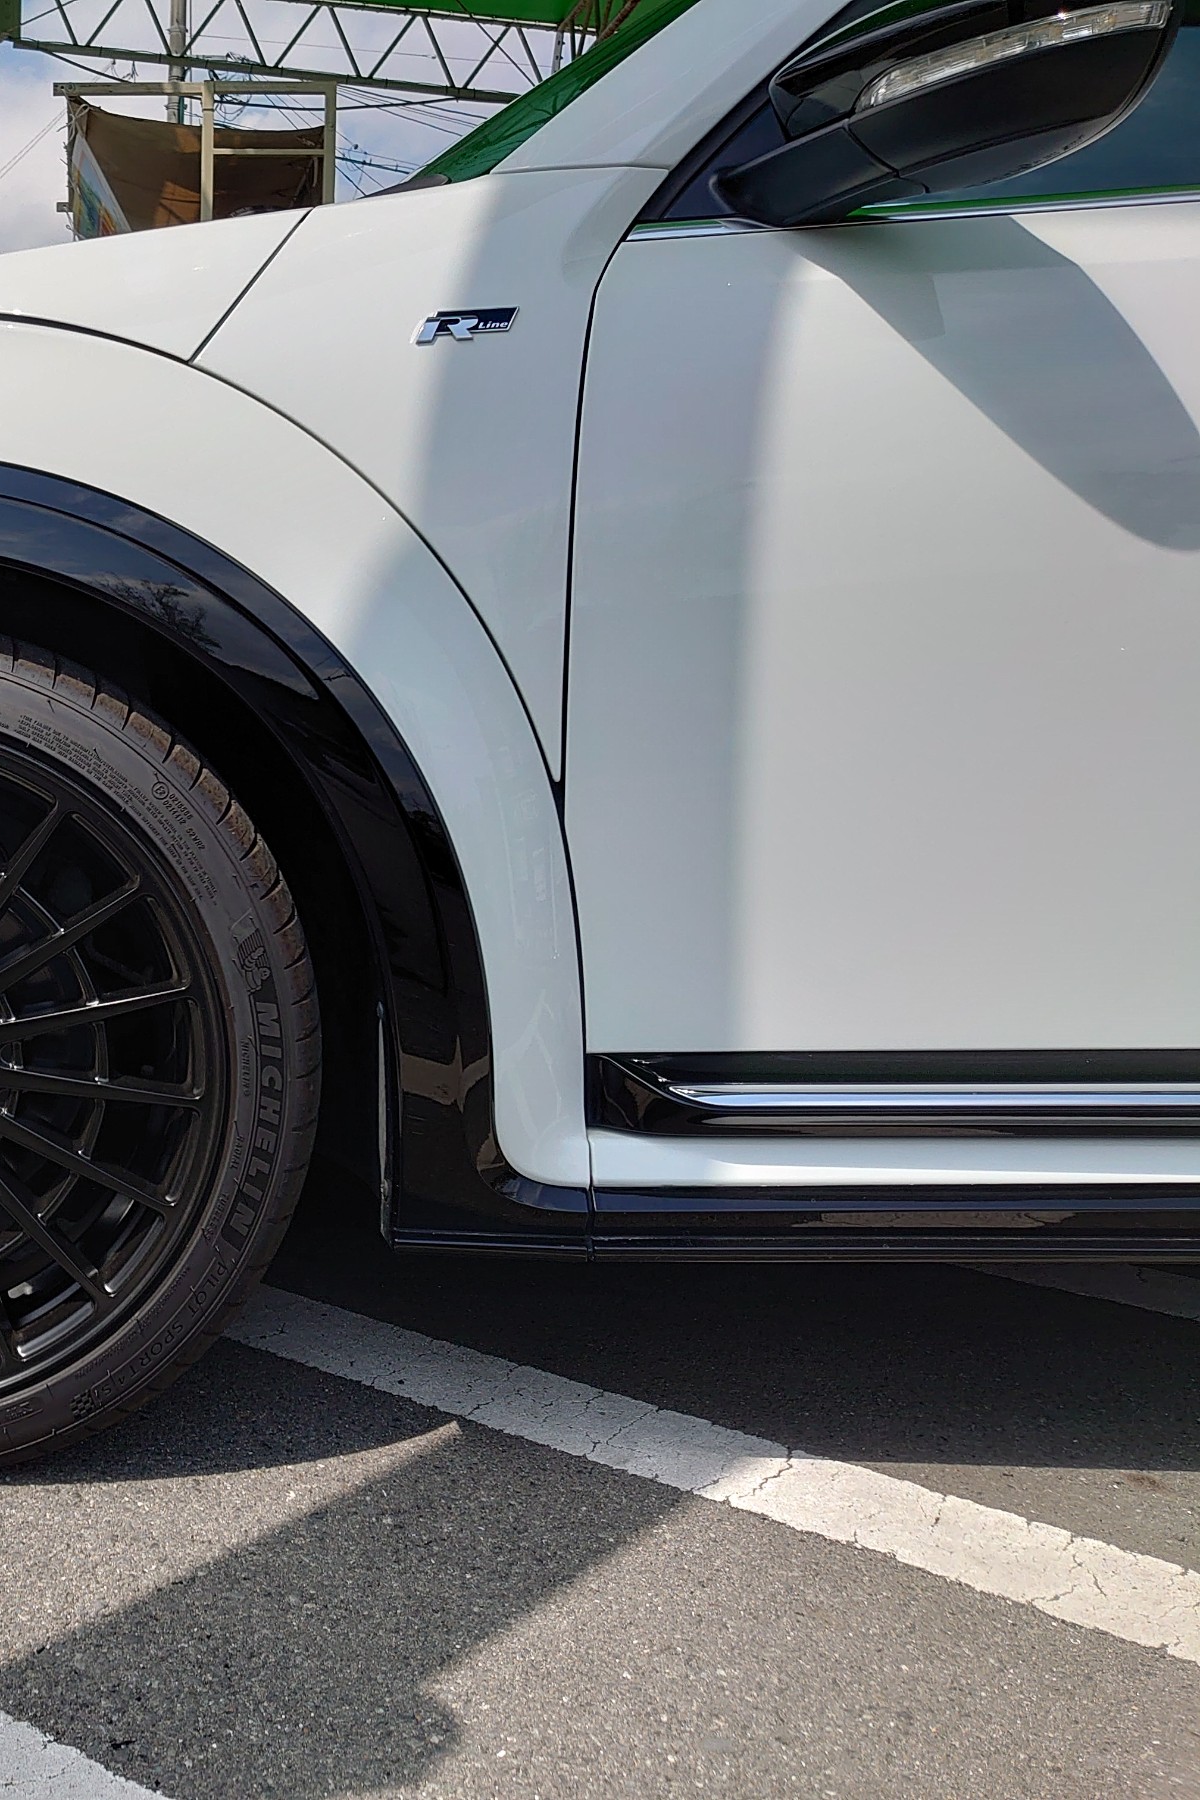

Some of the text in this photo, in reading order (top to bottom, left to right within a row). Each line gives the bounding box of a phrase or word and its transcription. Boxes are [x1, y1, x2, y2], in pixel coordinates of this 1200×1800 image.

[416, 315, 478, 344] R
[229, 1001, 282, 1237] MICHELIN
[187, 1261, 228, 1318] PILOT
[128, 1321, 184, 1378] SPORT
